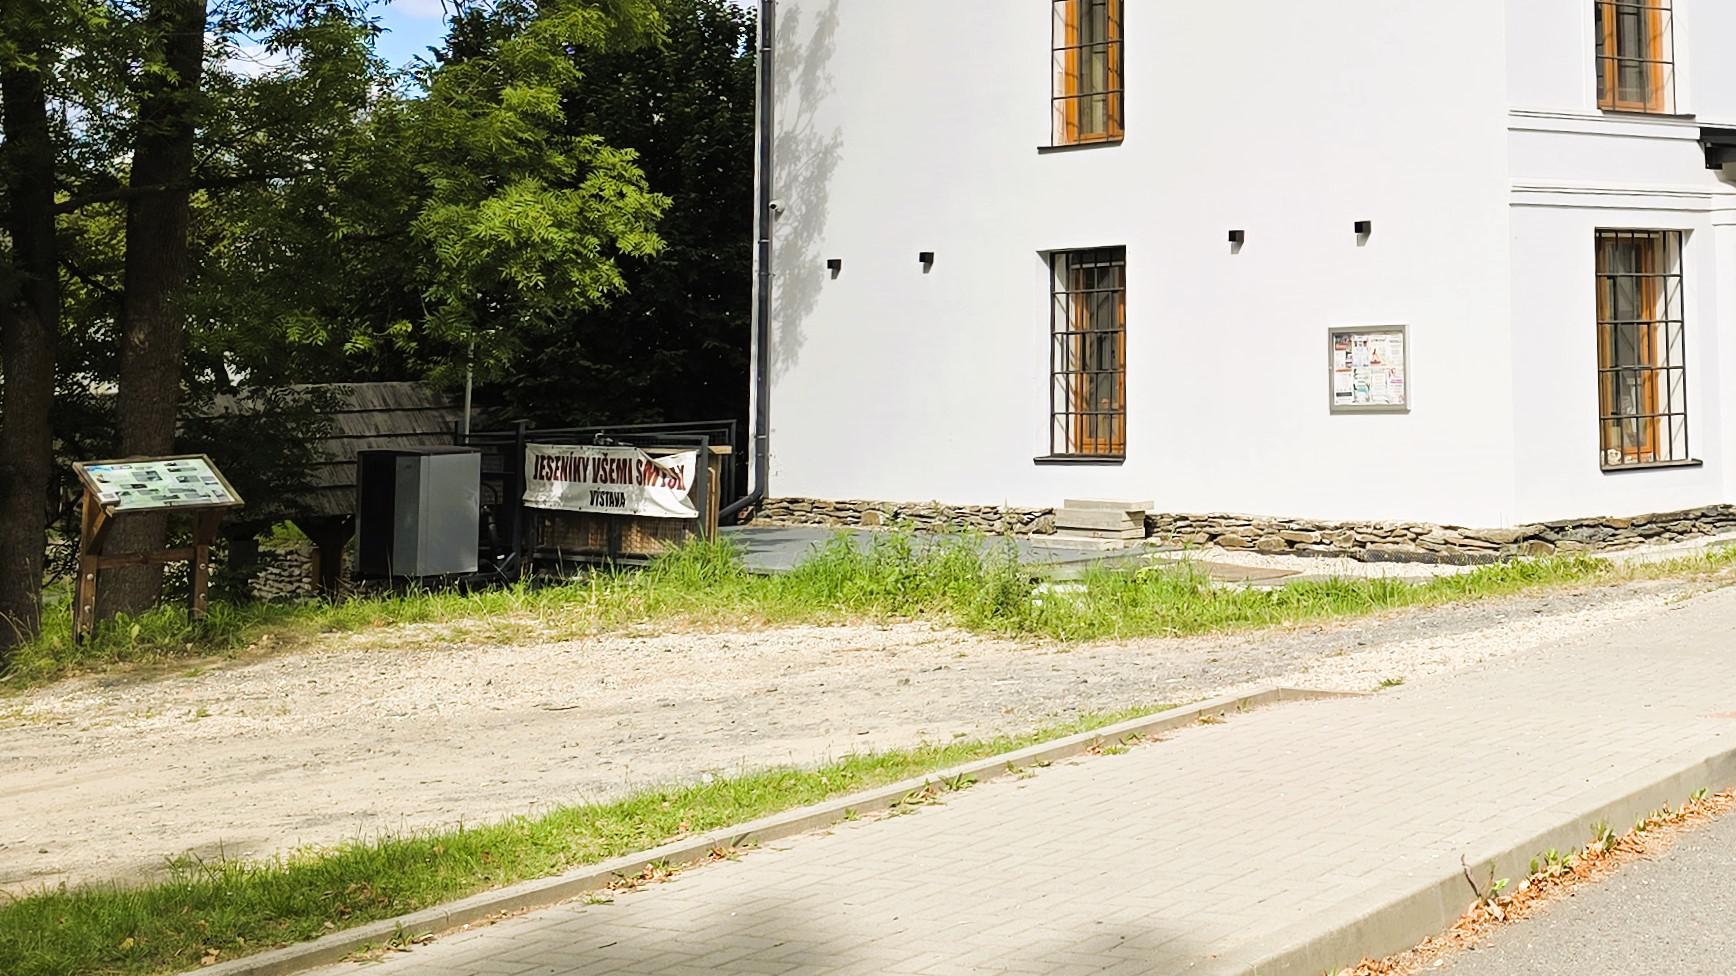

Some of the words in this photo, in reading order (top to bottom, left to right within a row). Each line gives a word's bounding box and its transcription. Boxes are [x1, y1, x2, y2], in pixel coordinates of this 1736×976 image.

[533, 452, 590, 484] JESENÍKY
[592, 453, 634, 485] VŠEMI
[589, 487, 626, 508] VÝSTAVA
